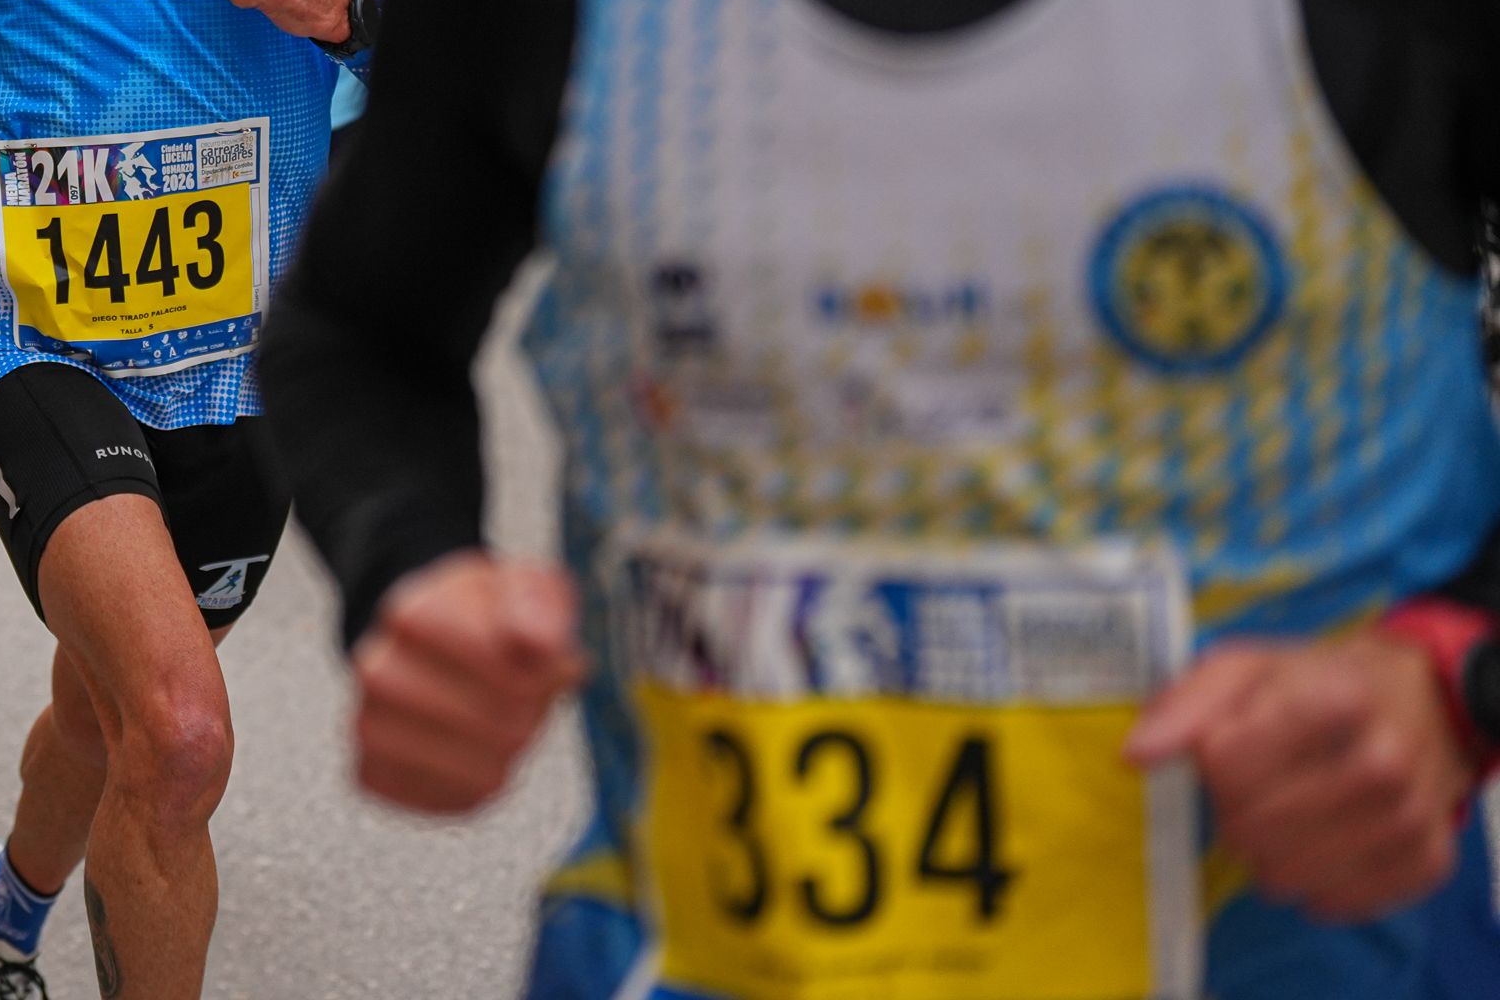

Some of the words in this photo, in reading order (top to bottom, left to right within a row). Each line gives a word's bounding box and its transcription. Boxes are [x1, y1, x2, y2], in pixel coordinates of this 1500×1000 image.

[161, 143, 183, 153] Ciudad
[184, 143, 193, 151] de
[161, 151, 193, 164] LUCENA
[201, 142, 245, 157] carreras
[201, 149, 253, 168] populares
[31, 148, 115, 205] 21K
[163, 173, 195, 192] 2026
[36, 199, 225, 305] 1443
[120, 313, 149, 321] TIRADO
[151, 305, 187, 317] PALACIOS
[704, 727, 1020, 931] 334
